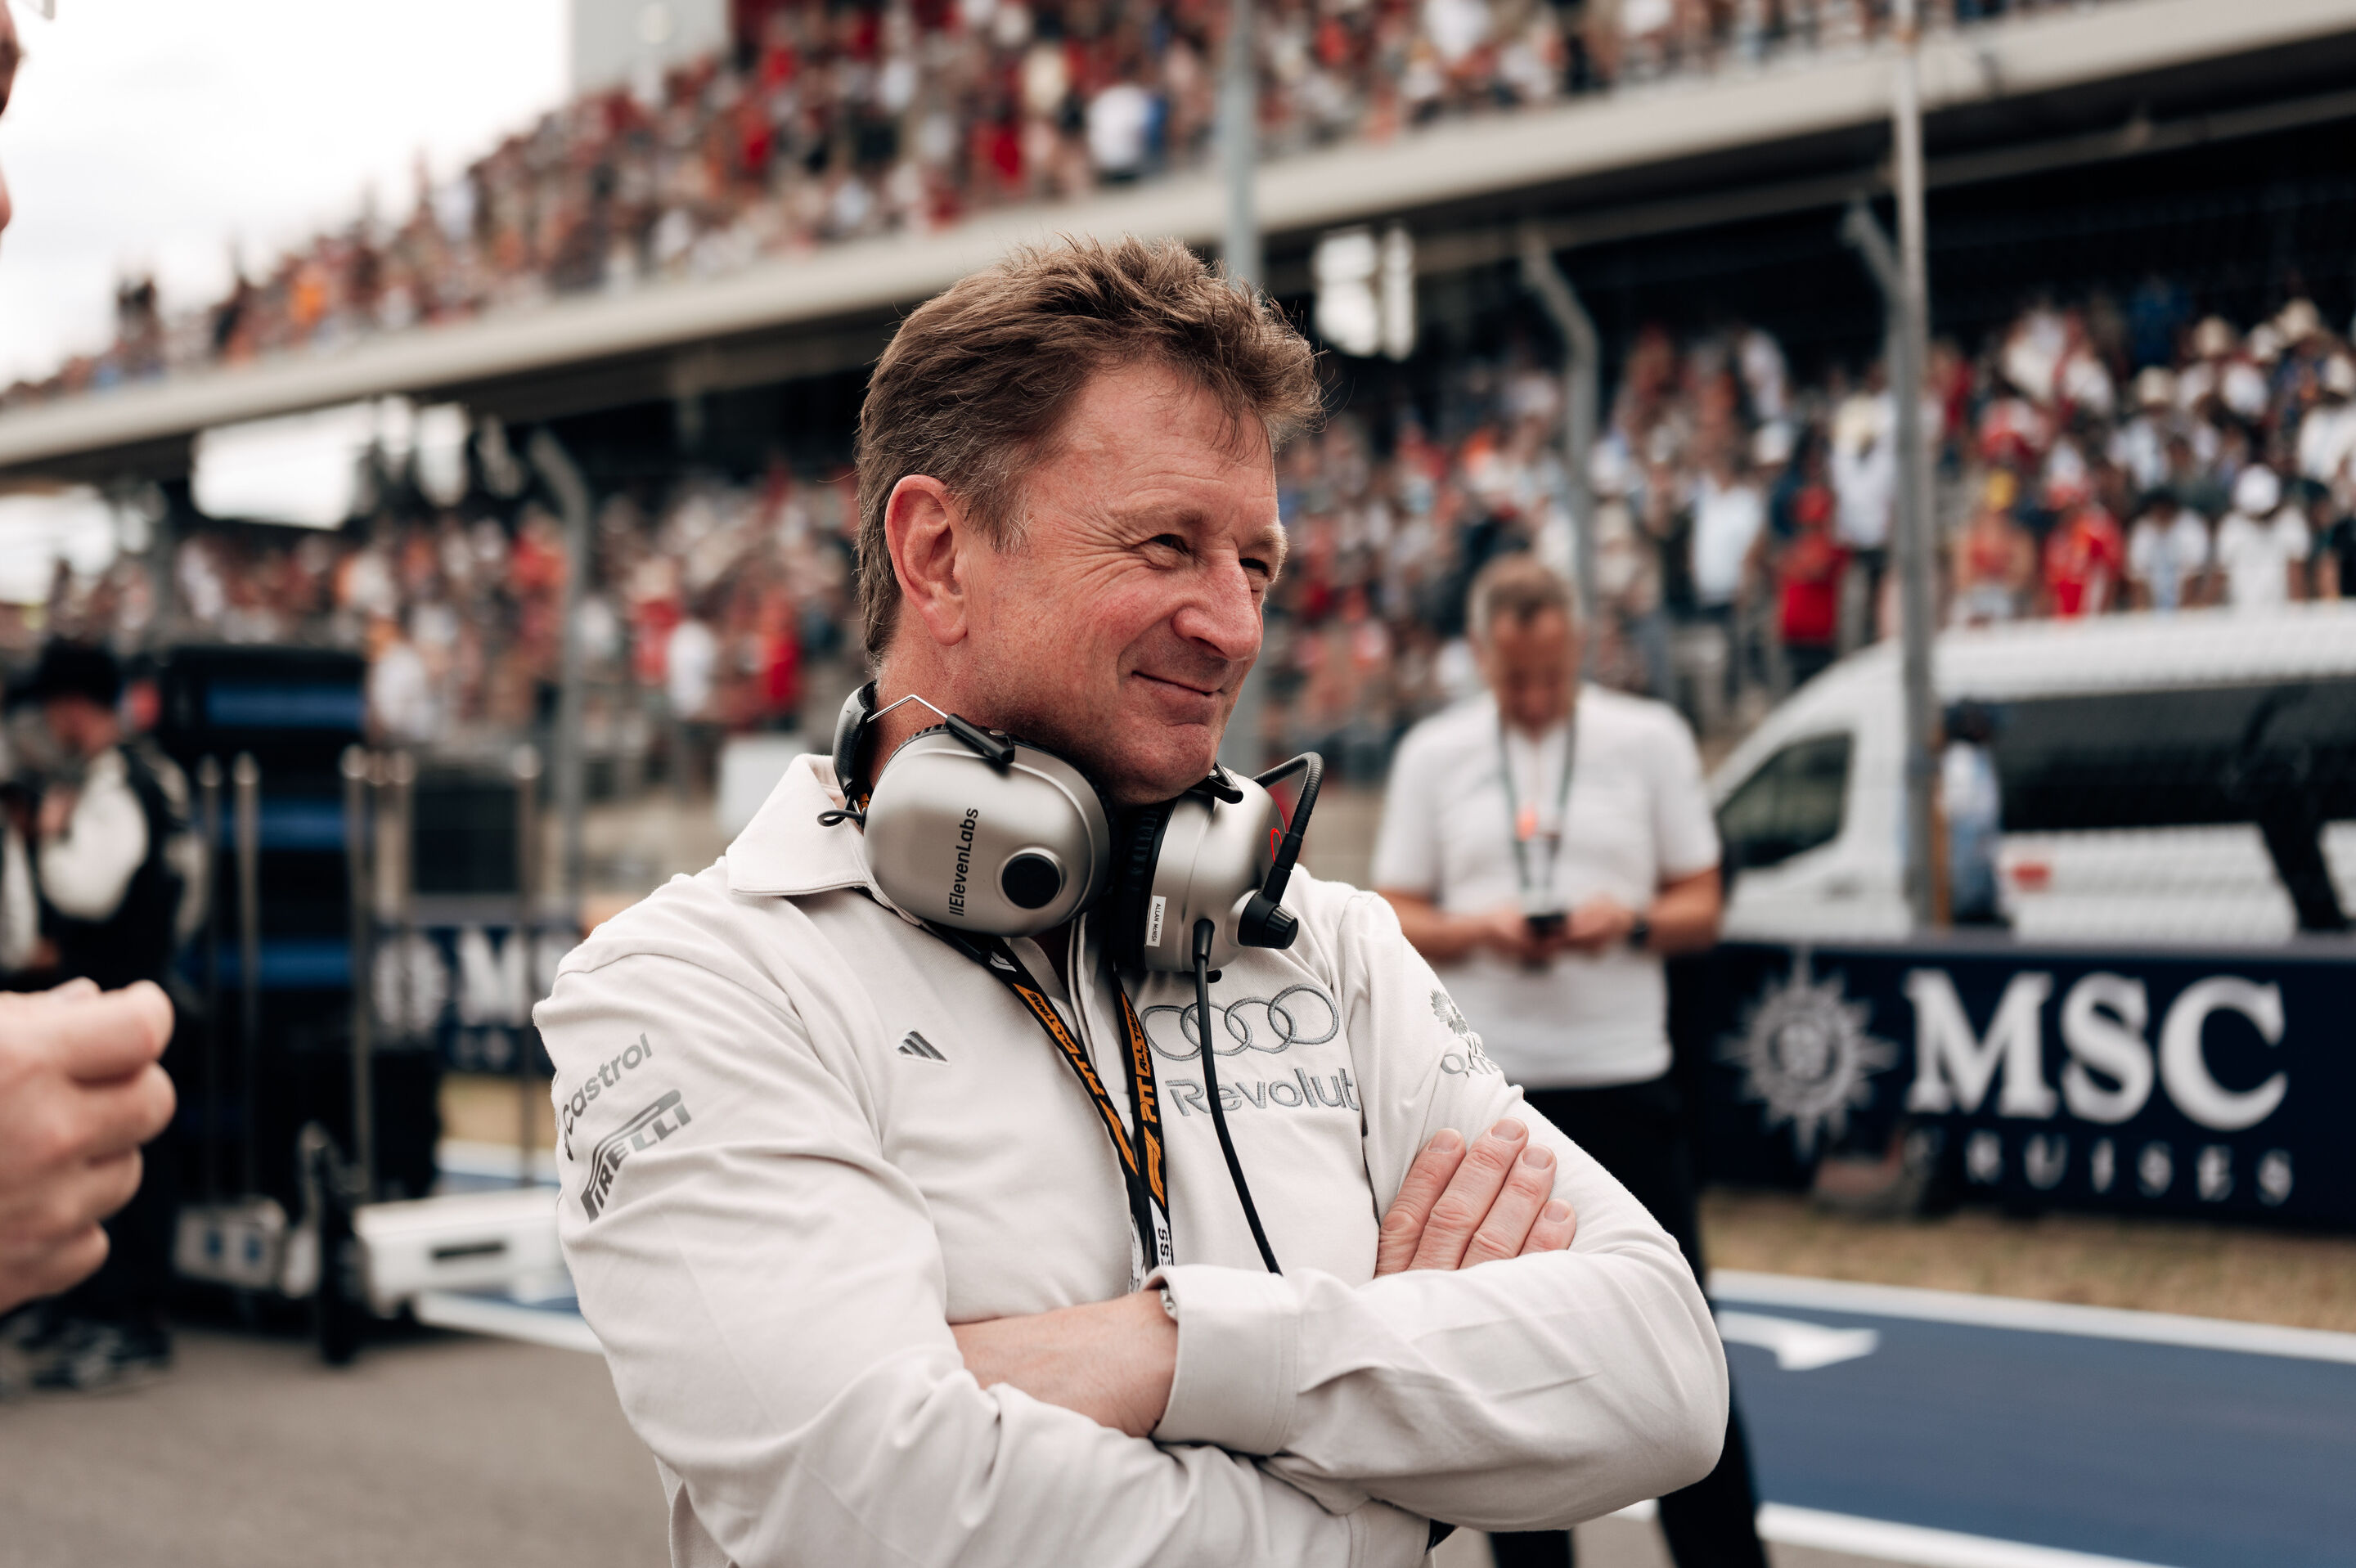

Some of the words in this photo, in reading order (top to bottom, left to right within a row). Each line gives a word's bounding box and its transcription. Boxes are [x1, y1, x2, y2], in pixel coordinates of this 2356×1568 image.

[1027, 992, 1056, 1025] TIME
[1057, 1026, 1076, 1050] ALL
[1136, 1045, 1148, 1072] ALL
[1904, 968, 2290, 1131] MSC
[562, 1032, 653, 1136] Castrol
[1072, 1054, 1106, 1096] PIT
[1165, 1067, 1360, 1116] Revolut
[1136, 1076, 1158, 1124] PIT
[580, 1089, 692, 1224] PIRELLI
[1906, 1127, 2294, 1206] RUISES
